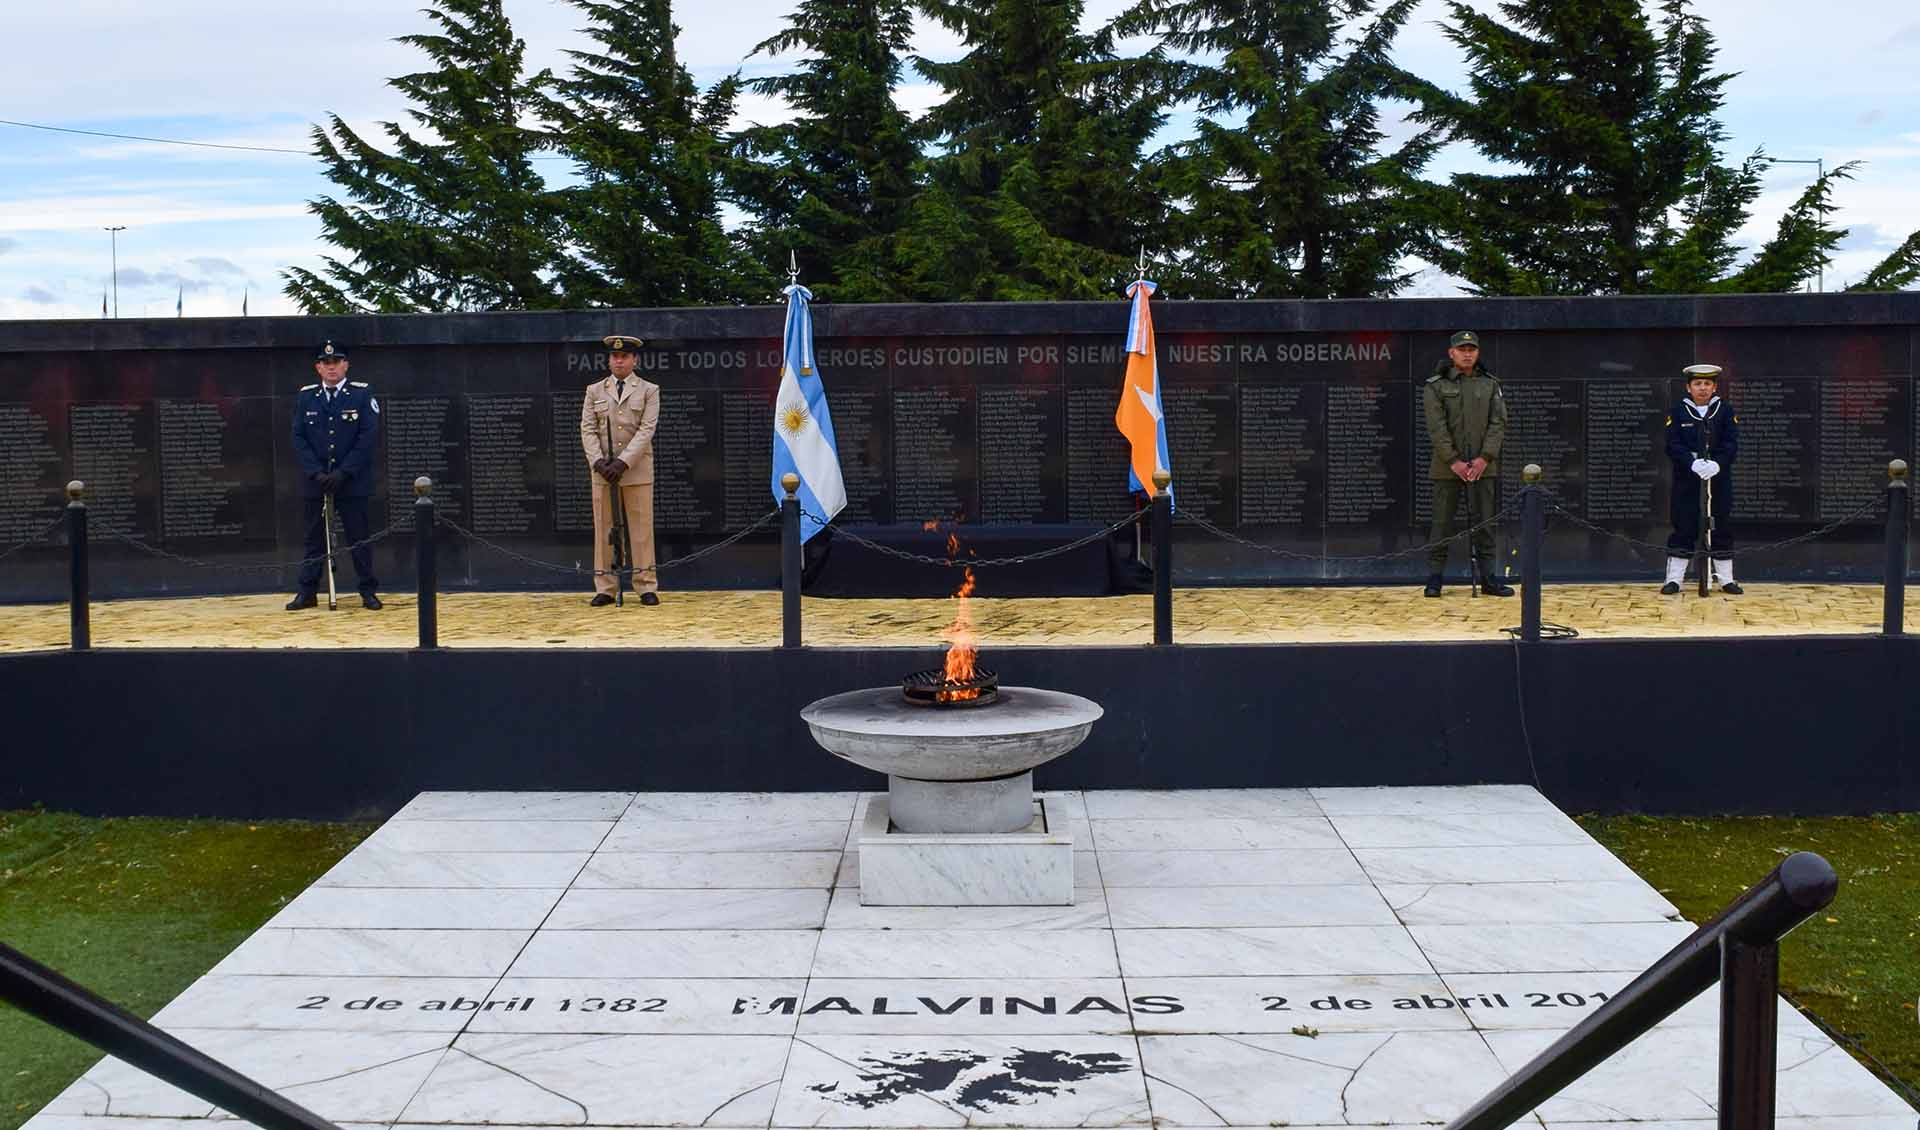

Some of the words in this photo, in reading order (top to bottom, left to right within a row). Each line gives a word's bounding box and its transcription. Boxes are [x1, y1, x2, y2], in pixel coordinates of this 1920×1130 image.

[567, 352, 607, 371] PAR
[638, 351, 669, 370] UE
[675, 351, 747, 370] TODOS
[757, 349, 783, 369] LO
[817, 348, 886, 368] EROES
[895, 346, 1009, 366] CUSTODIEN
[1017, 346, 1059, 365] POR
[1066, 345, 1123, 365] SIEM
[1276, 343, 1392, 362] SOBERANIA
[295, 995, 331, 1010] 2
[343, 996, 403, 1011] de
[418, 996, 536, 1011] abril
[732, 995, 1185, 1015] MALVINAS
[1261, 996, 1292, 1011] 2
[1309, 995, 1373, 1011] de
[1391, 992, 1510, 1010] abril
[1523, 992, 1610, 1008] 201
